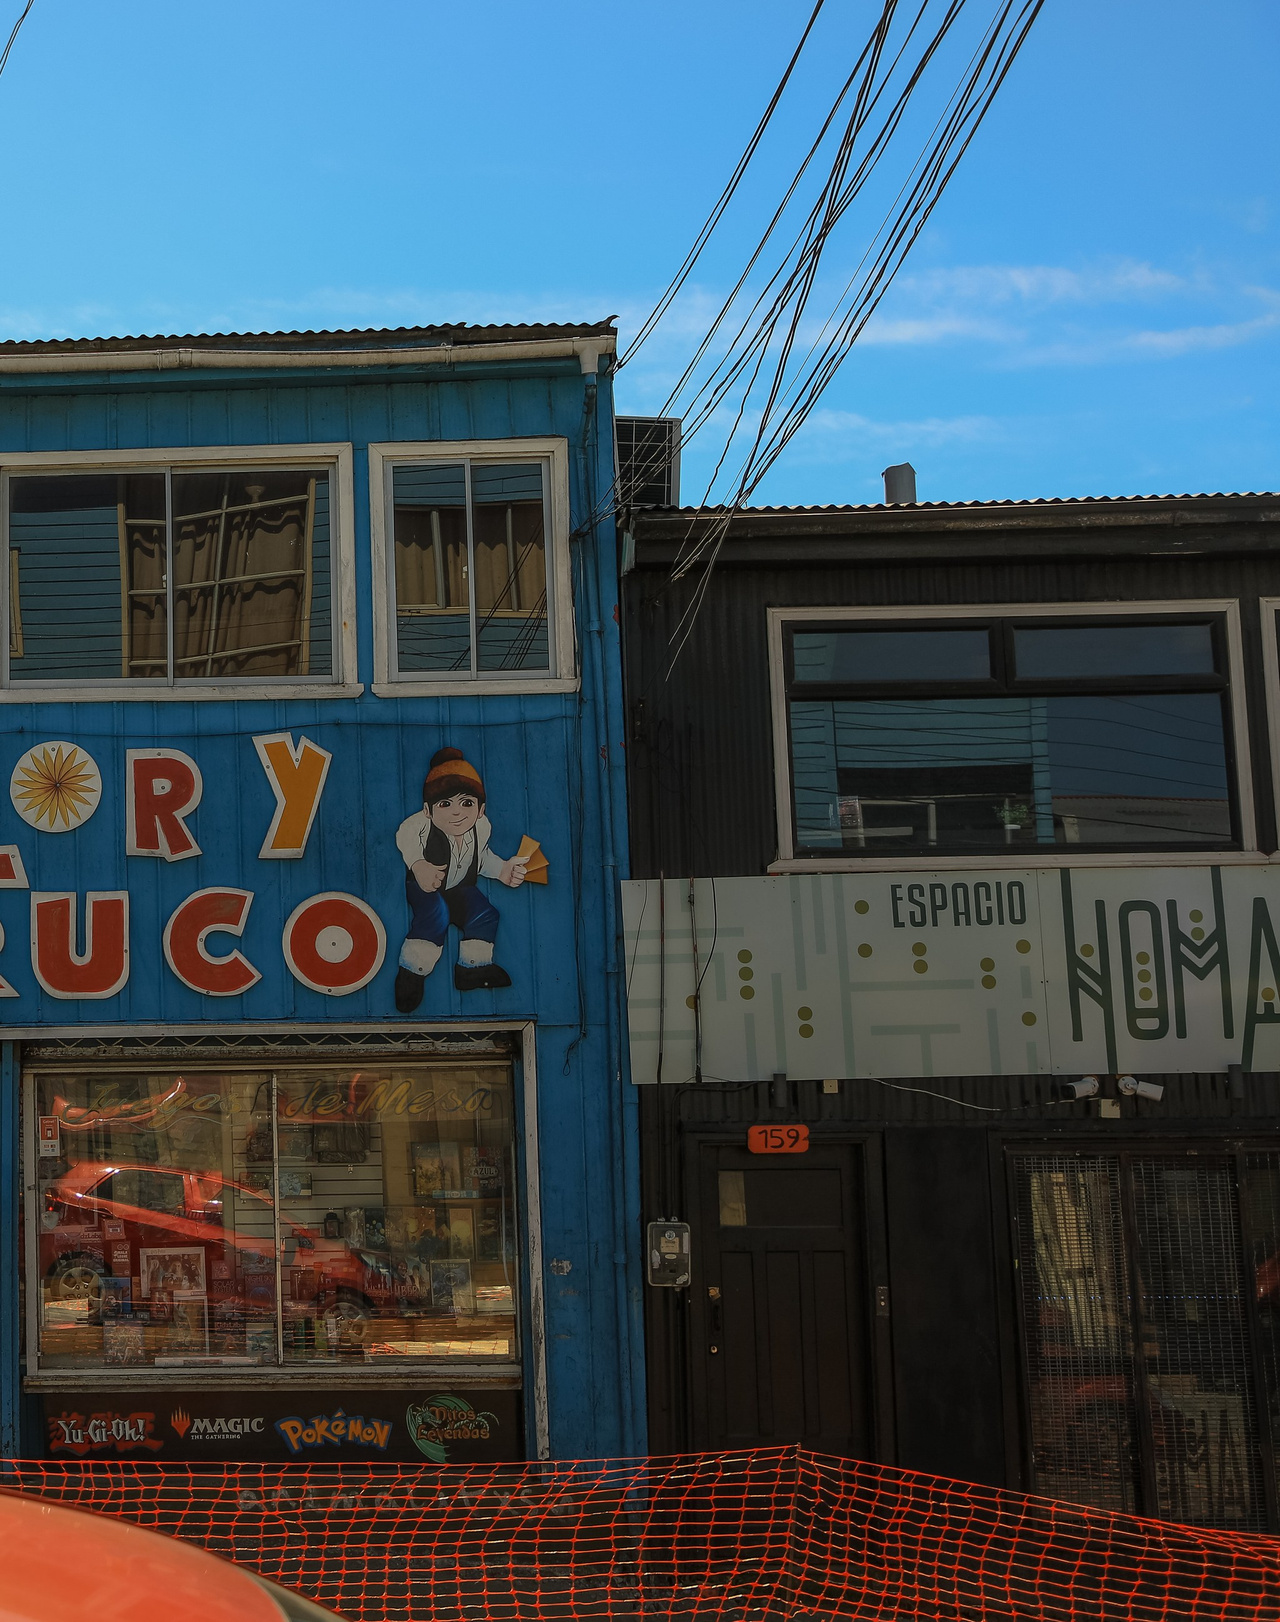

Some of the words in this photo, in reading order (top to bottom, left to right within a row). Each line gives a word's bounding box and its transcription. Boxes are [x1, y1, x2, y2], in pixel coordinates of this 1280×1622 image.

[251, 731, 333, 859] Y
[890, 880, 1028, 929] ESPACIO
[284, 1079, 346, 1118] de
[354, 1078, 495, 1117] Mesa
[757, 1127, 801, 1150] 159
[473, 1166, 495, 1176] AZUL
[190, 1417, 265, 1434] MAGIC
[429, 1406, 477, 1422] Mitos
[57, 1417, 146, 1444] Yu-Gi-Oh!
[417, 1423, 490, 1442] Leyendas
